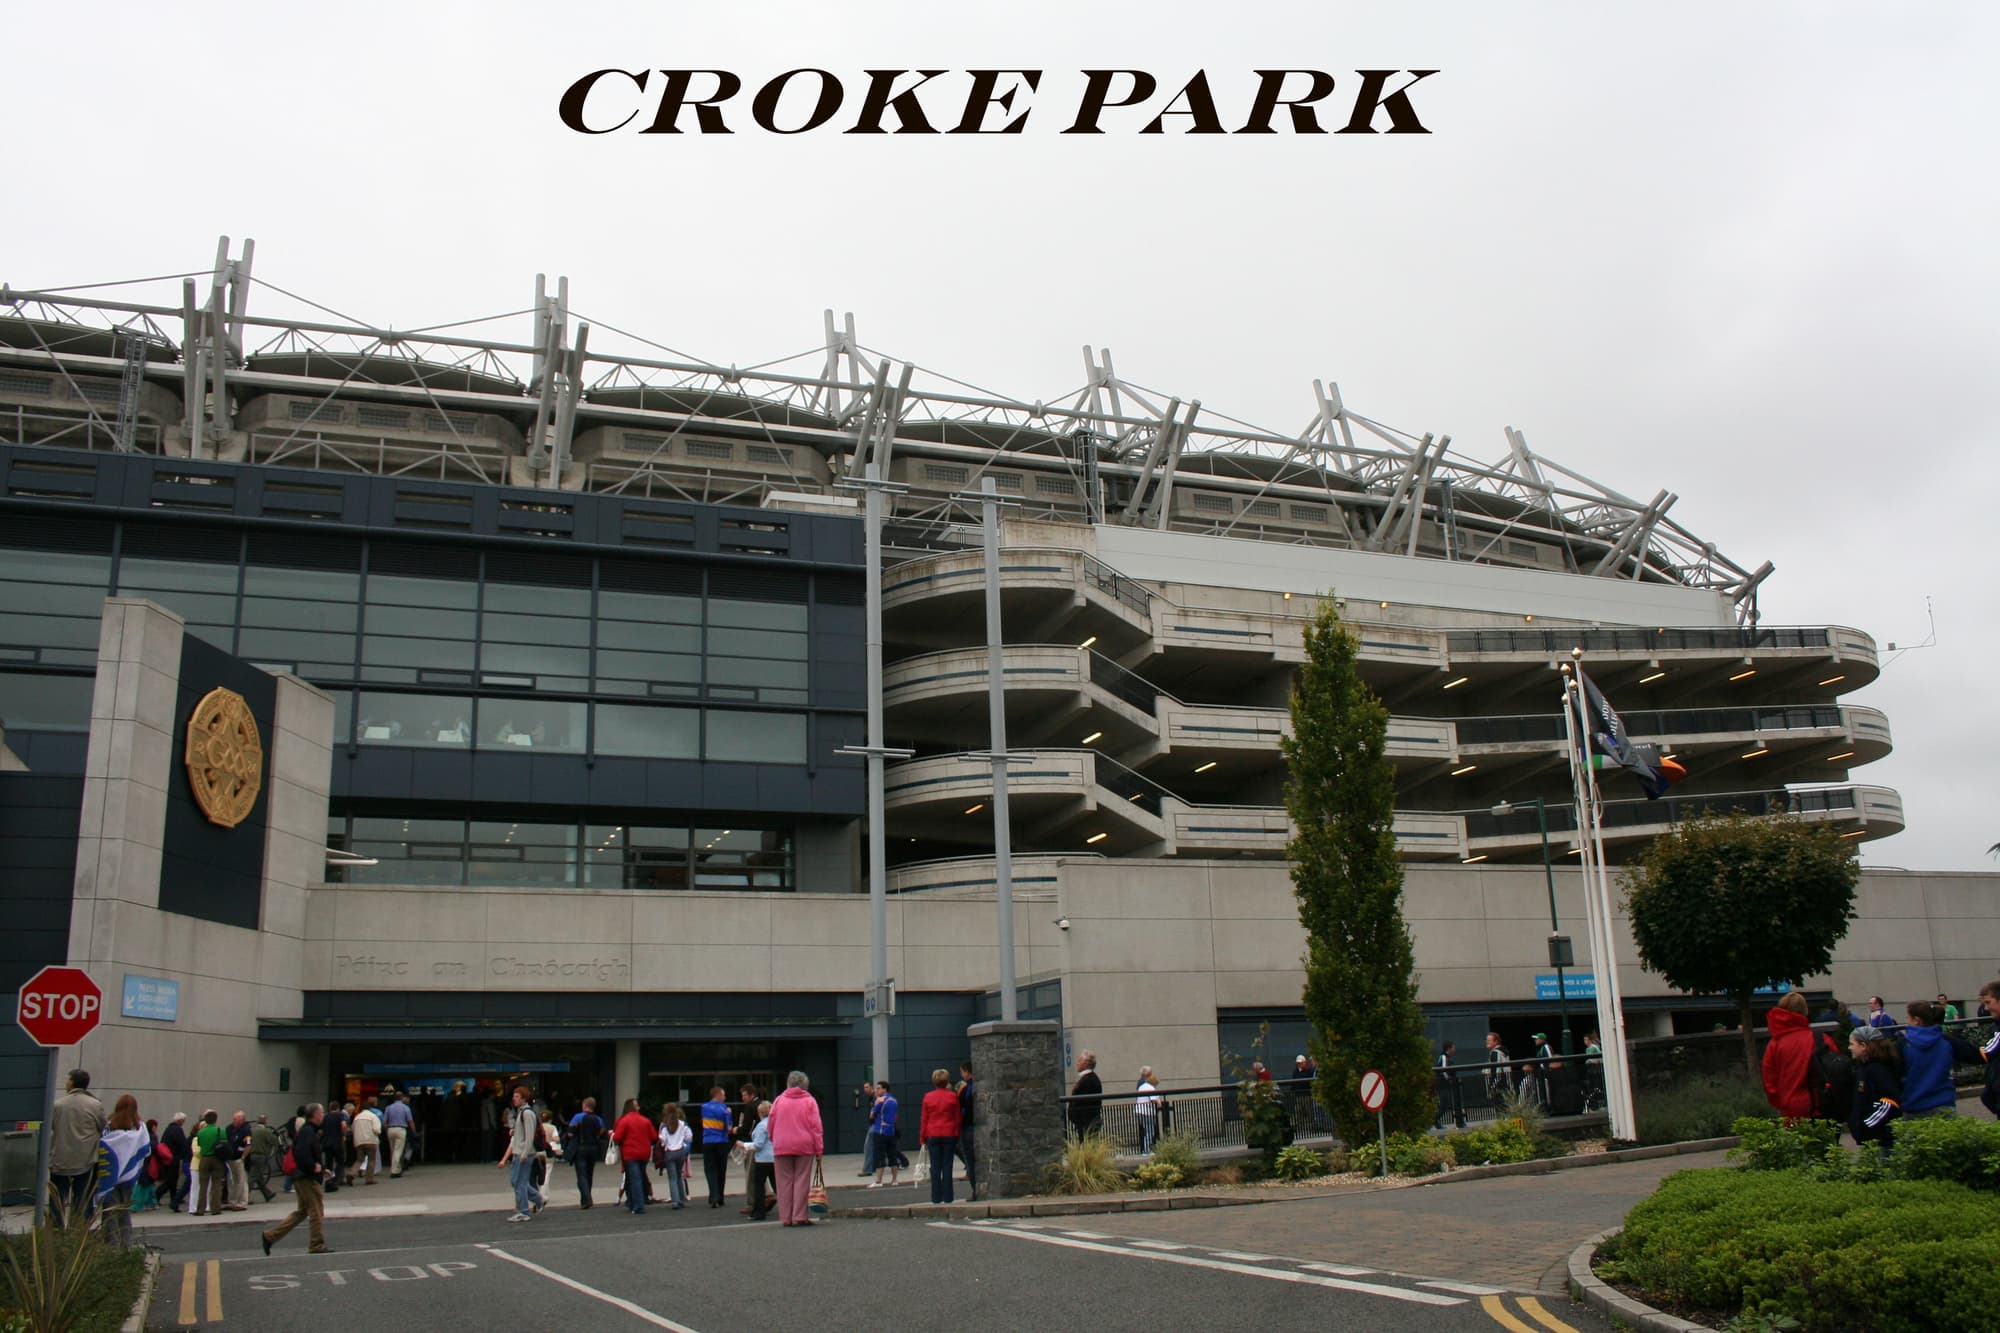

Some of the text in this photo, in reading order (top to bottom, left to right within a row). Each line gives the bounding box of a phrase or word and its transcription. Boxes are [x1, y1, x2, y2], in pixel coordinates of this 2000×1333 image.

[432, 961, 468, 976] an
[22, 992, 99, 1020] STOP
[247, 1261, 478, 1290] STOP
